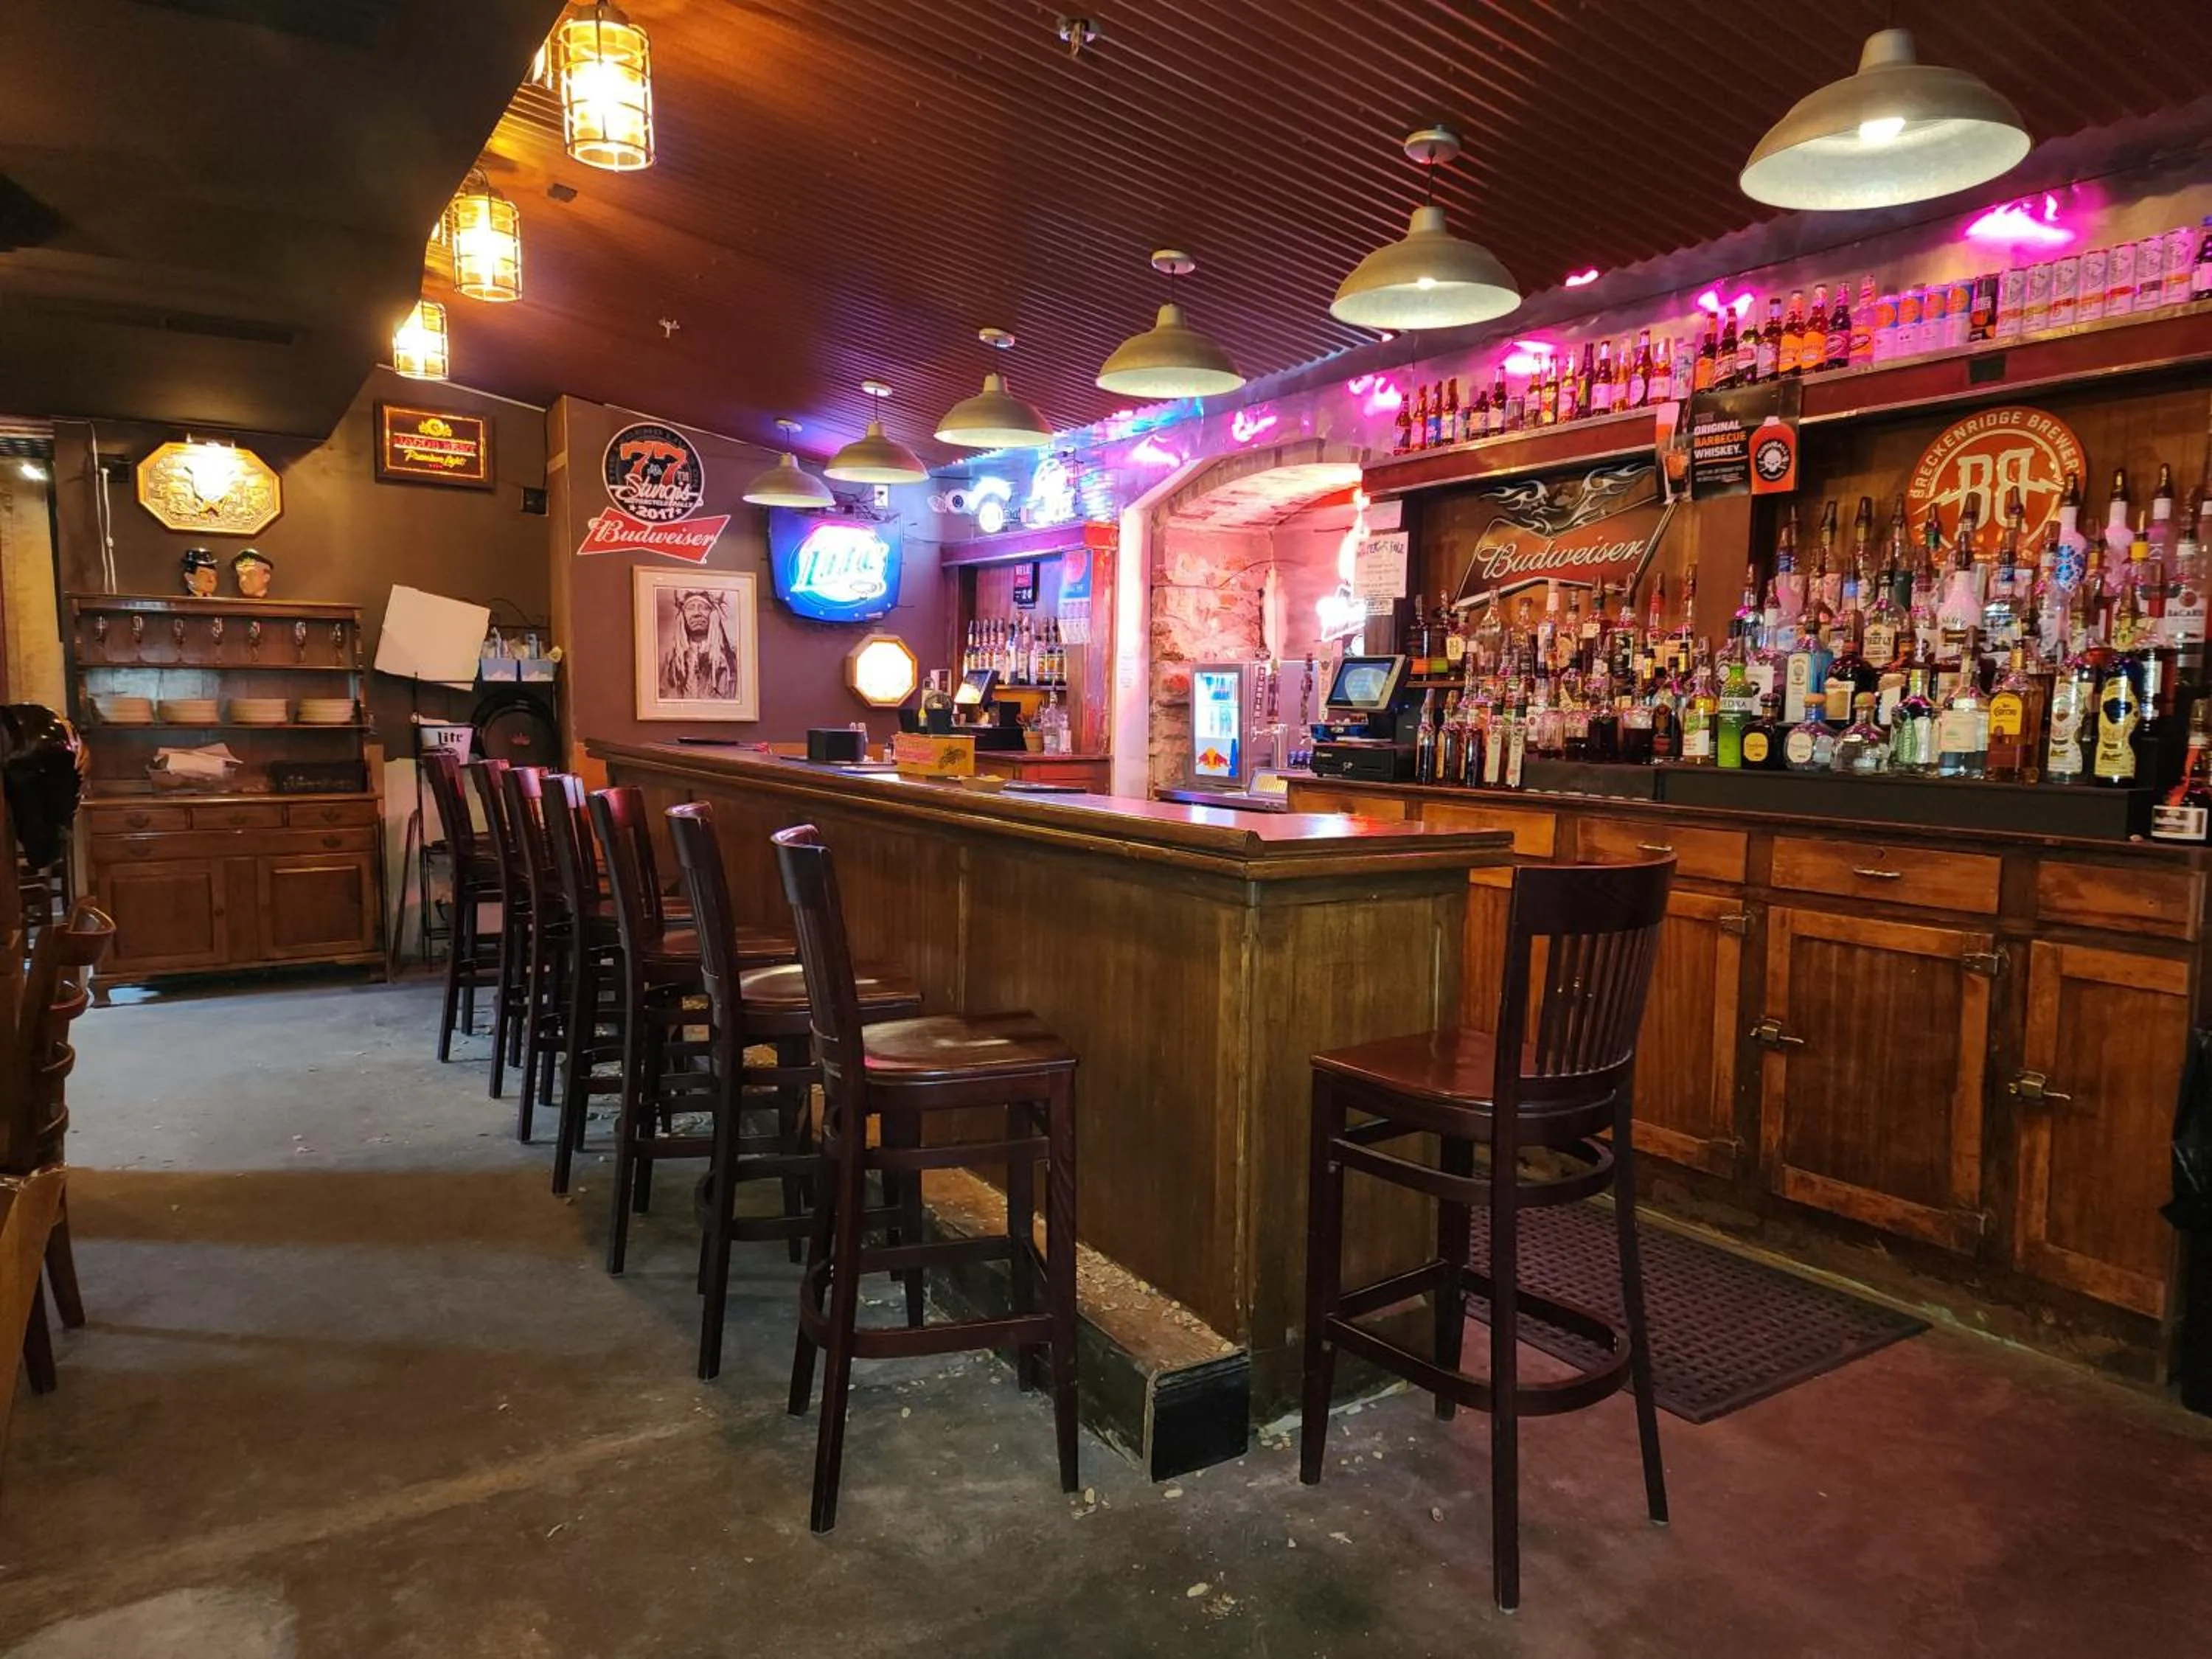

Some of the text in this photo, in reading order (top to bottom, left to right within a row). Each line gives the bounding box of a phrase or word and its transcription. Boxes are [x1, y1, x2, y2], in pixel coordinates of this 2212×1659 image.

[1694, 420, 1742, 436] ORIGINAL
[1694, 431, 1747, 448] BARBECUE
[1694, 443, 1743, 459] WHISKEY.
[1909, 411, 2080, 499] BRECKENRIDGE BREWER
[620, 441, 687, 487] 77
[612, 473, 695, 507] Sturgis
[636, 505, 675, 520] 2017
[588, 518, 717, 547] Budweiser
[1478, 536, 1646, 580] Budweiser
[437, 731, 464, 745] Lite
